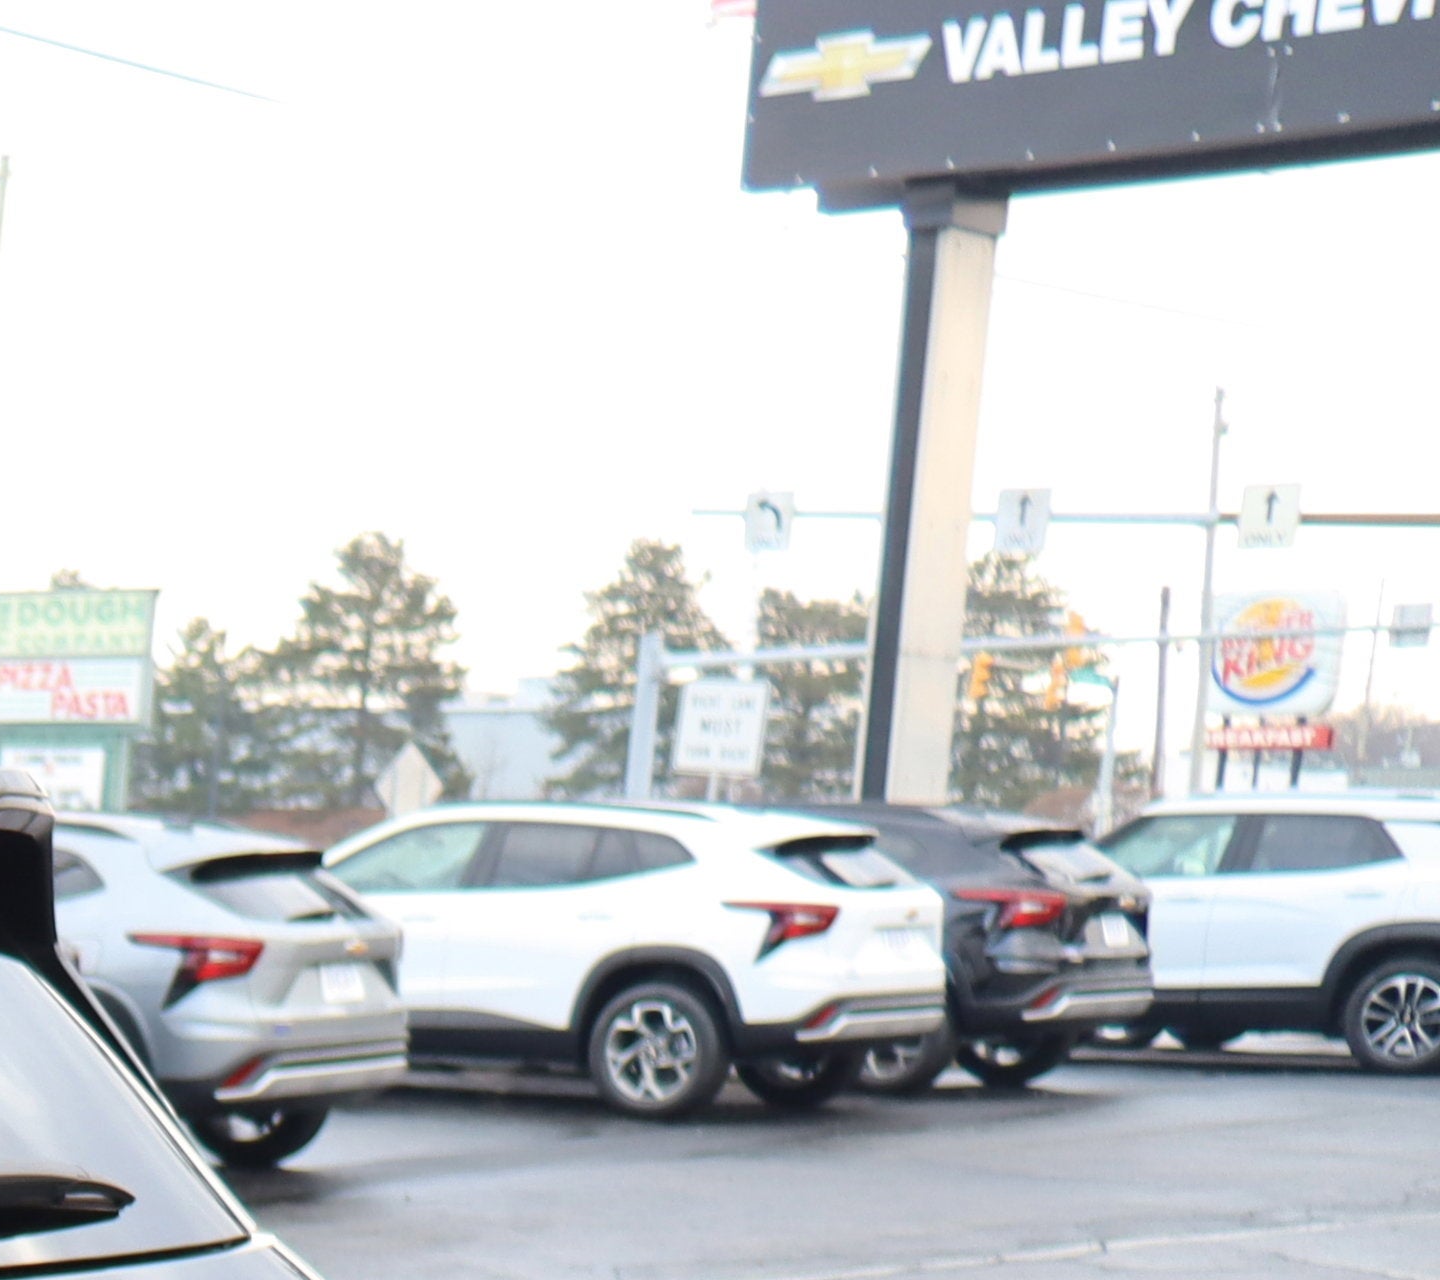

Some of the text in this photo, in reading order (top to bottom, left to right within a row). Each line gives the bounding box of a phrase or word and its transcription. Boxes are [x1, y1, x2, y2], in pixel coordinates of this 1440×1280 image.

[942, 0, 1194, 83] VALLEY
[18, 599, 147, 627] DOUGH
[51, 690, 130, 720] PASTA
